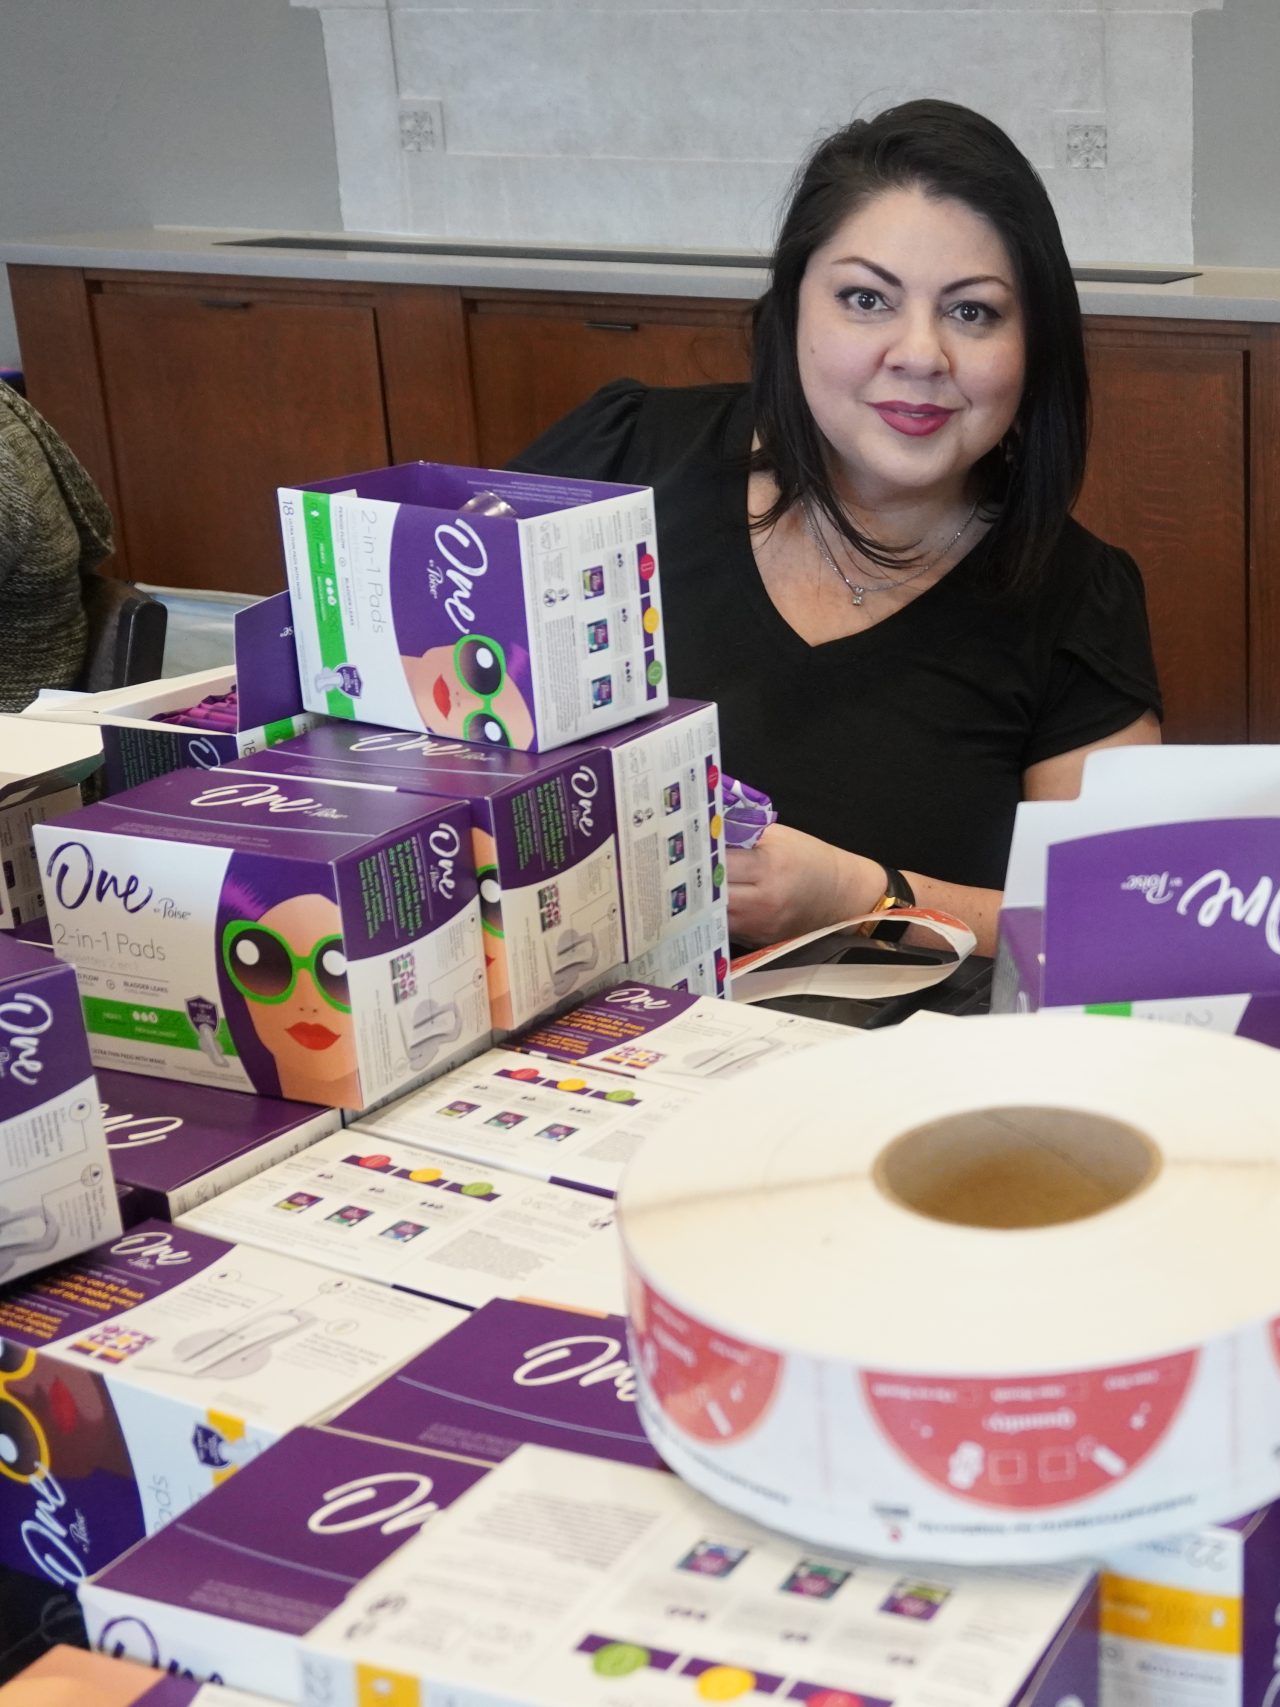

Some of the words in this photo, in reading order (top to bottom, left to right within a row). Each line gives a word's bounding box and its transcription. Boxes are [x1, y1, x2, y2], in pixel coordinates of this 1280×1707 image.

[282, 500, 294, 515] 18
[361, 510, 381, 573] 2-in-1
[434, 518, 488, 634] One
[368, 582, 387, 634] Pads
[350, 732, 469, 757] One
[190, 783, 322, 813] One
[571, 765, 598, 837] One
[46, 841, 153, 914] One
[429, 822, 461, 899] One
[54, 923, 110, 951] 2-in-1
[117, 933, 166, 961] Pads
[605, 987, 671, 1010] One
[0, 992, 53, 1085] One
[110, 1231, 192, 1266] One
[513, 1335, 639, 1401] On
[21, 1461, 87, 1586] One
[148, 1474, 172, 1528] ads
